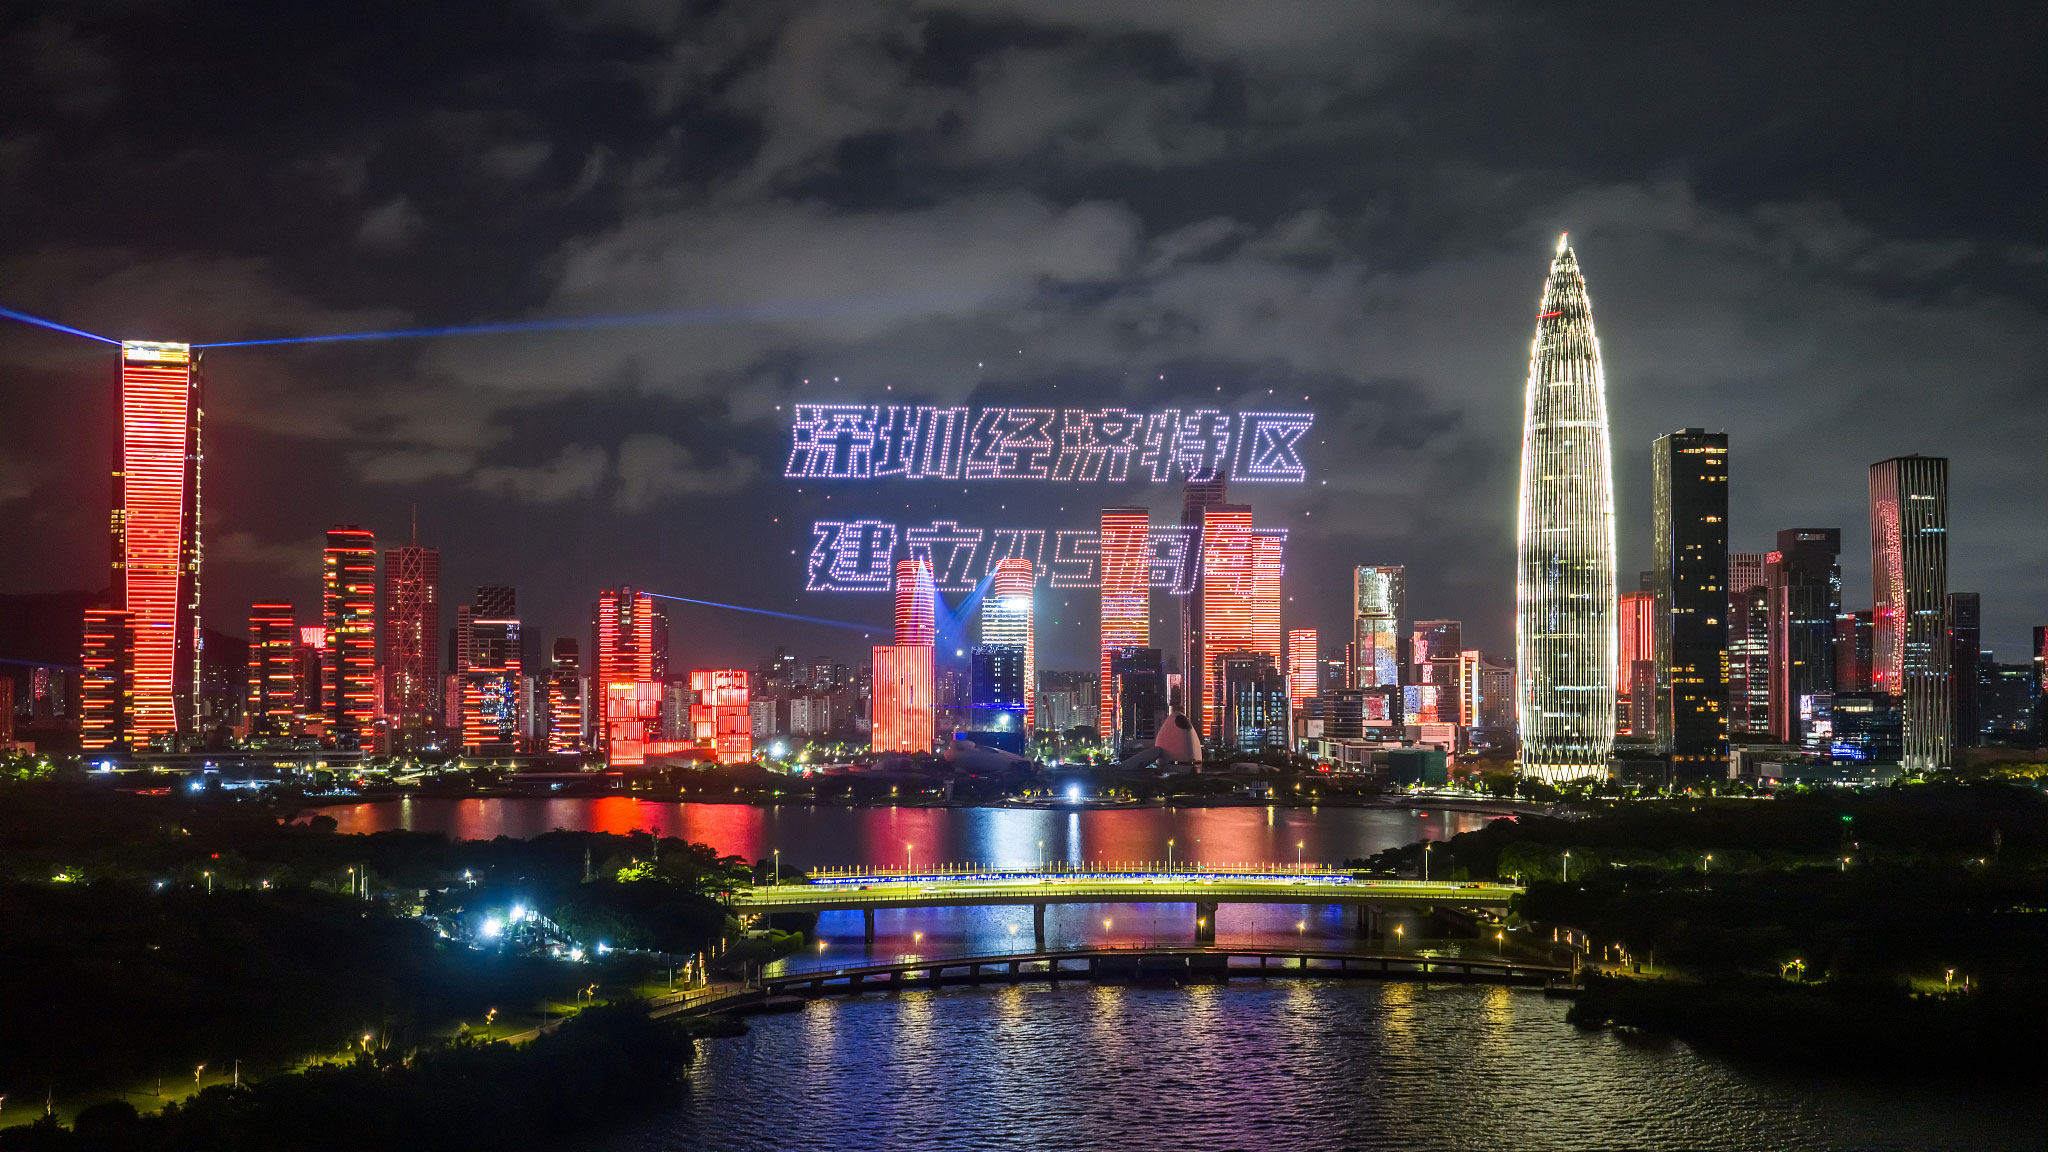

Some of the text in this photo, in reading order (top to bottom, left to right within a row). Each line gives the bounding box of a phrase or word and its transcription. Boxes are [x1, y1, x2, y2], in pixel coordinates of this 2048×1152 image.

[784, 404, 1315, 483] 深圳经济特区
